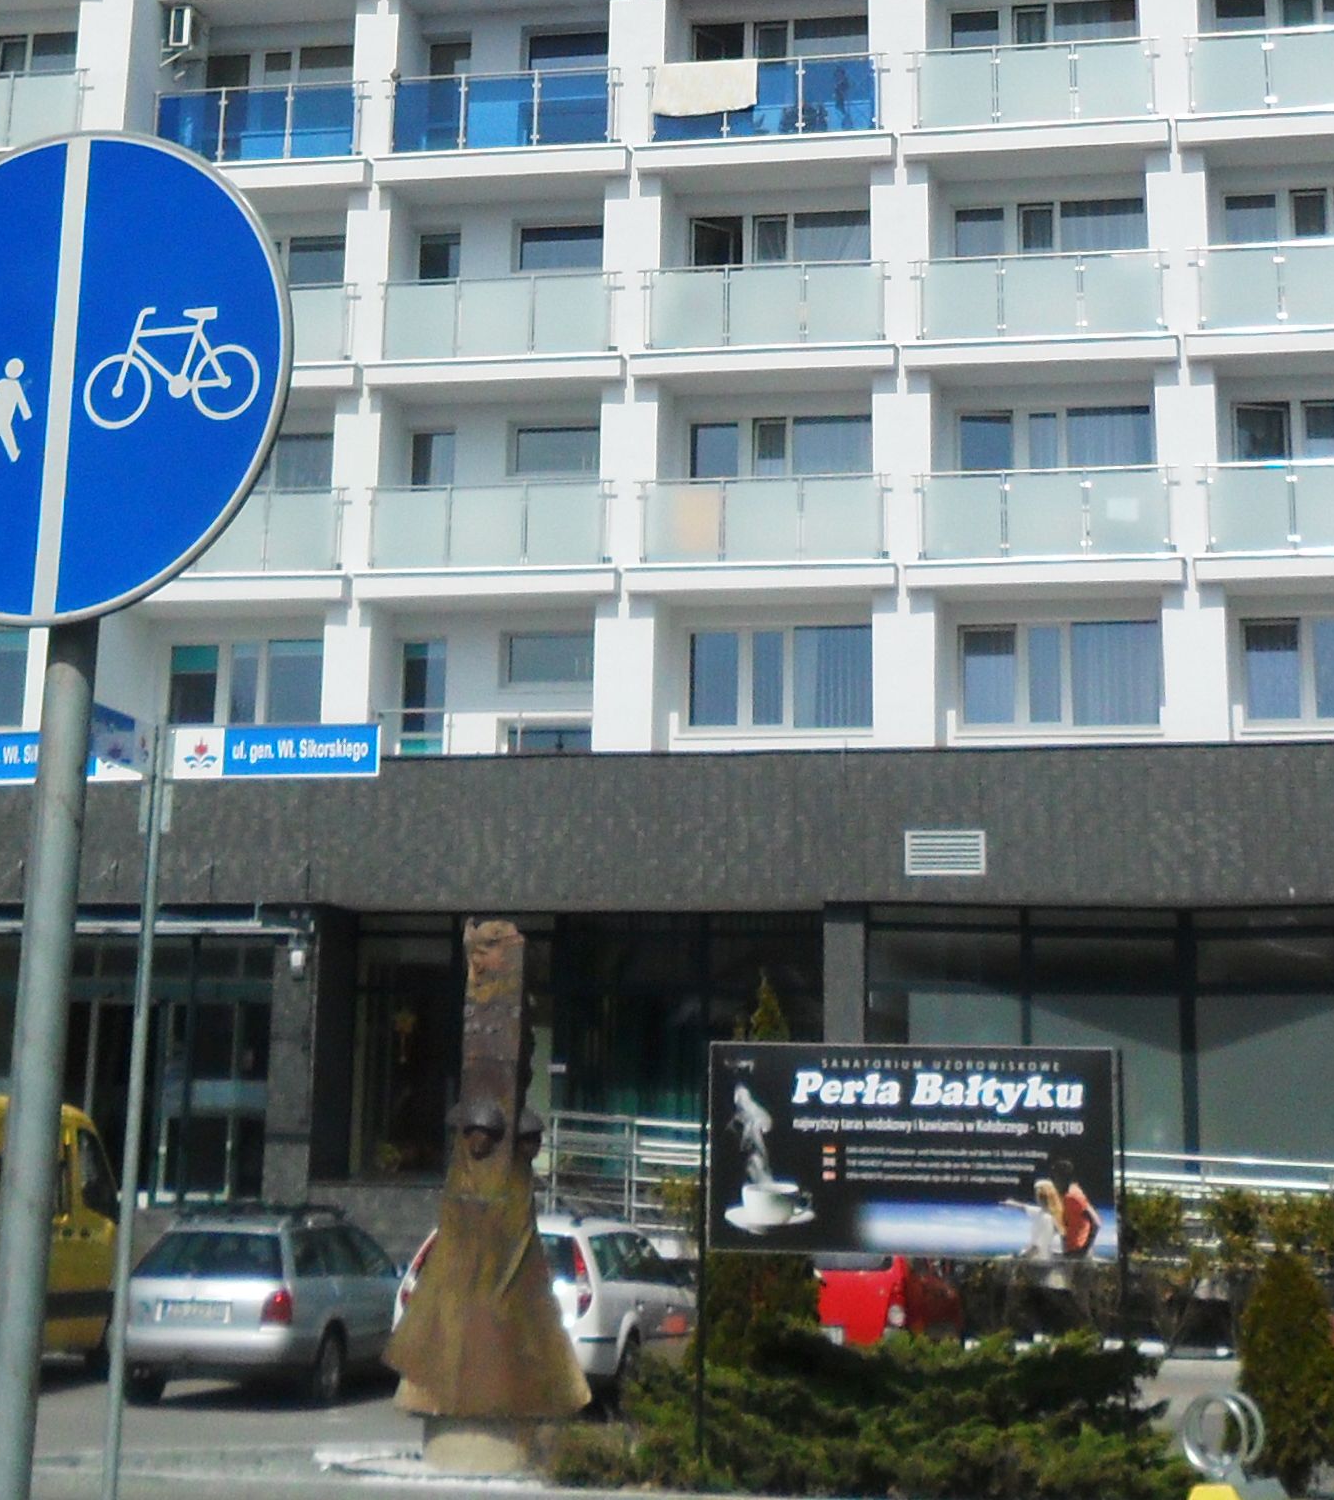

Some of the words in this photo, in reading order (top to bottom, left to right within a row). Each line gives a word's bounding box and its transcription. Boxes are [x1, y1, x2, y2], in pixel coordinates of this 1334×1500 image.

[232, 740, 246, 759] ul.
[250, 745, 274, 764] gen.
[299, 738, 369, 762] Sikorskiego
[821, 1057, 922, 1070] SANATORIUM
[932, 1060, 1060, 1073] UZDROWISKOWE
[791, 1070, 901, 1105] Perła
[910, 1072, 1084, 1113] Bałtyku
[865, 1118, 912, 1134] widokowy
[919, 1119, 965, 1133] kawiarnia
[1037, 1121, 1048, 1134] 12
